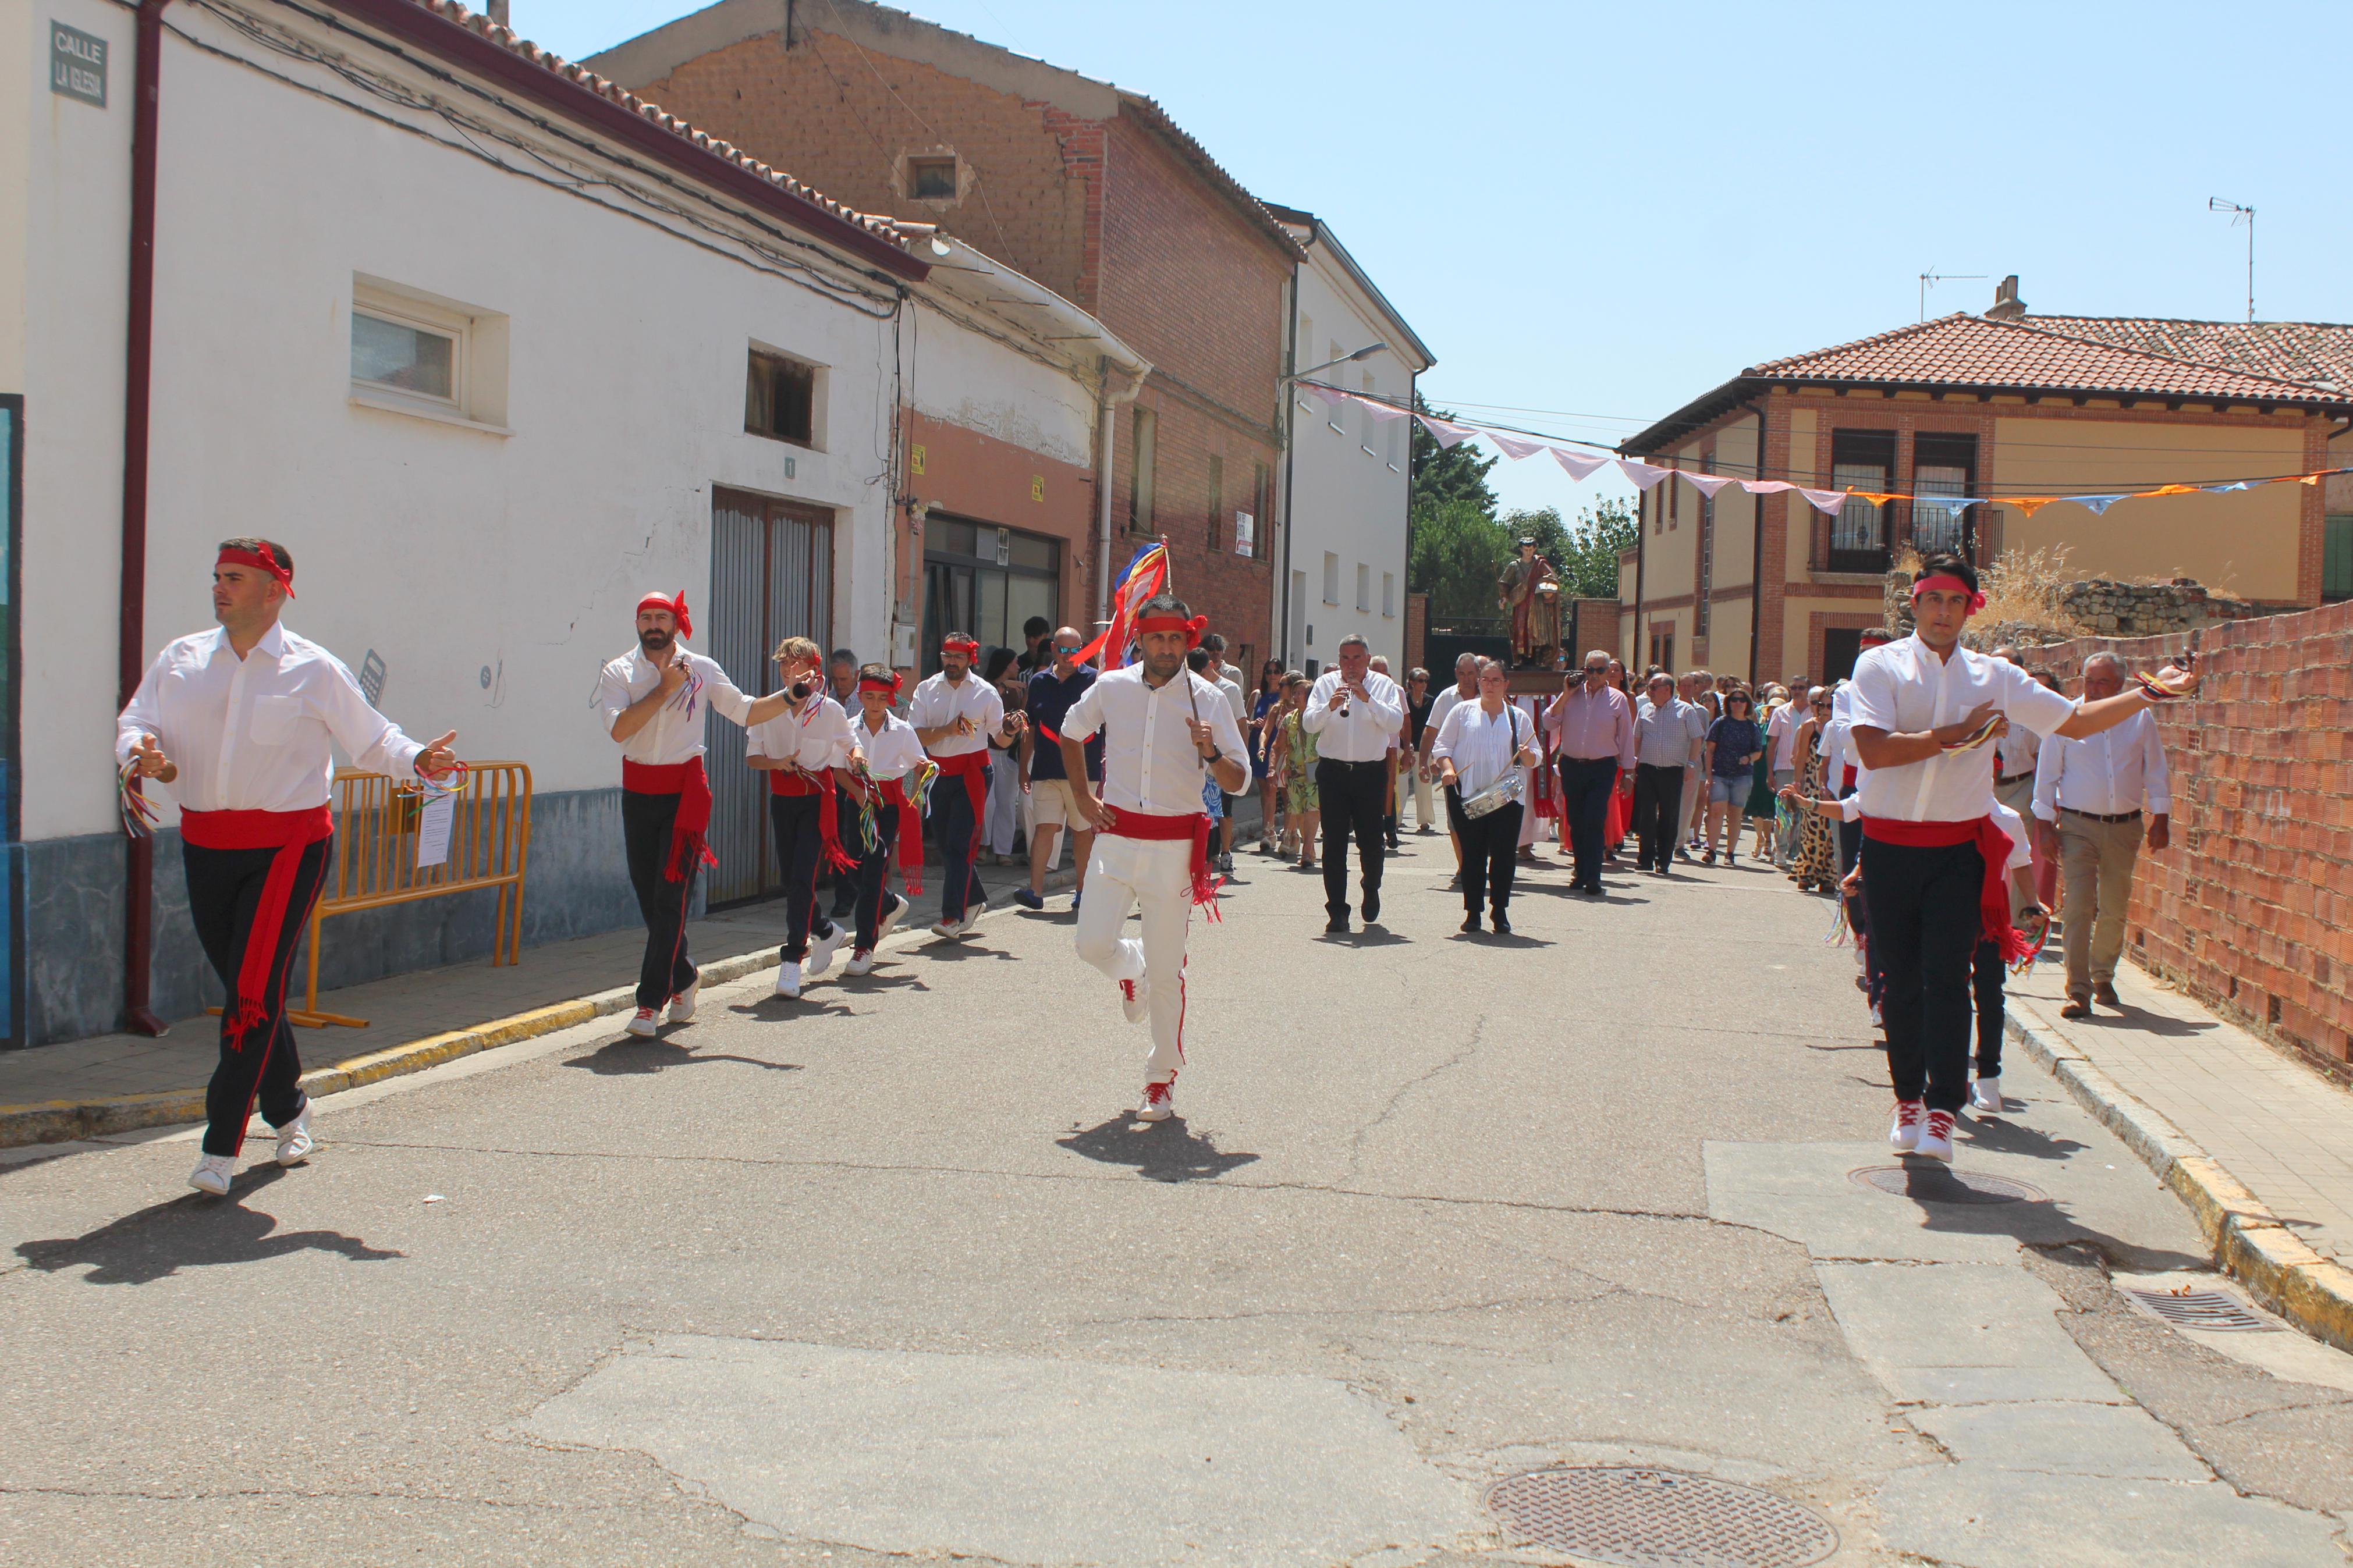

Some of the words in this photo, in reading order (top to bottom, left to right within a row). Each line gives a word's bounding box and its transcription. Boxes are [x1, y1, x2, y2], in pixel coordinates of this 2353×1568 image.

[55, 31, 102, 65] CALLE
[55, 61, 69, 87] LA
[69, 65, 102, 98] IGLESIA
[787, 461, 792, 475] 1
